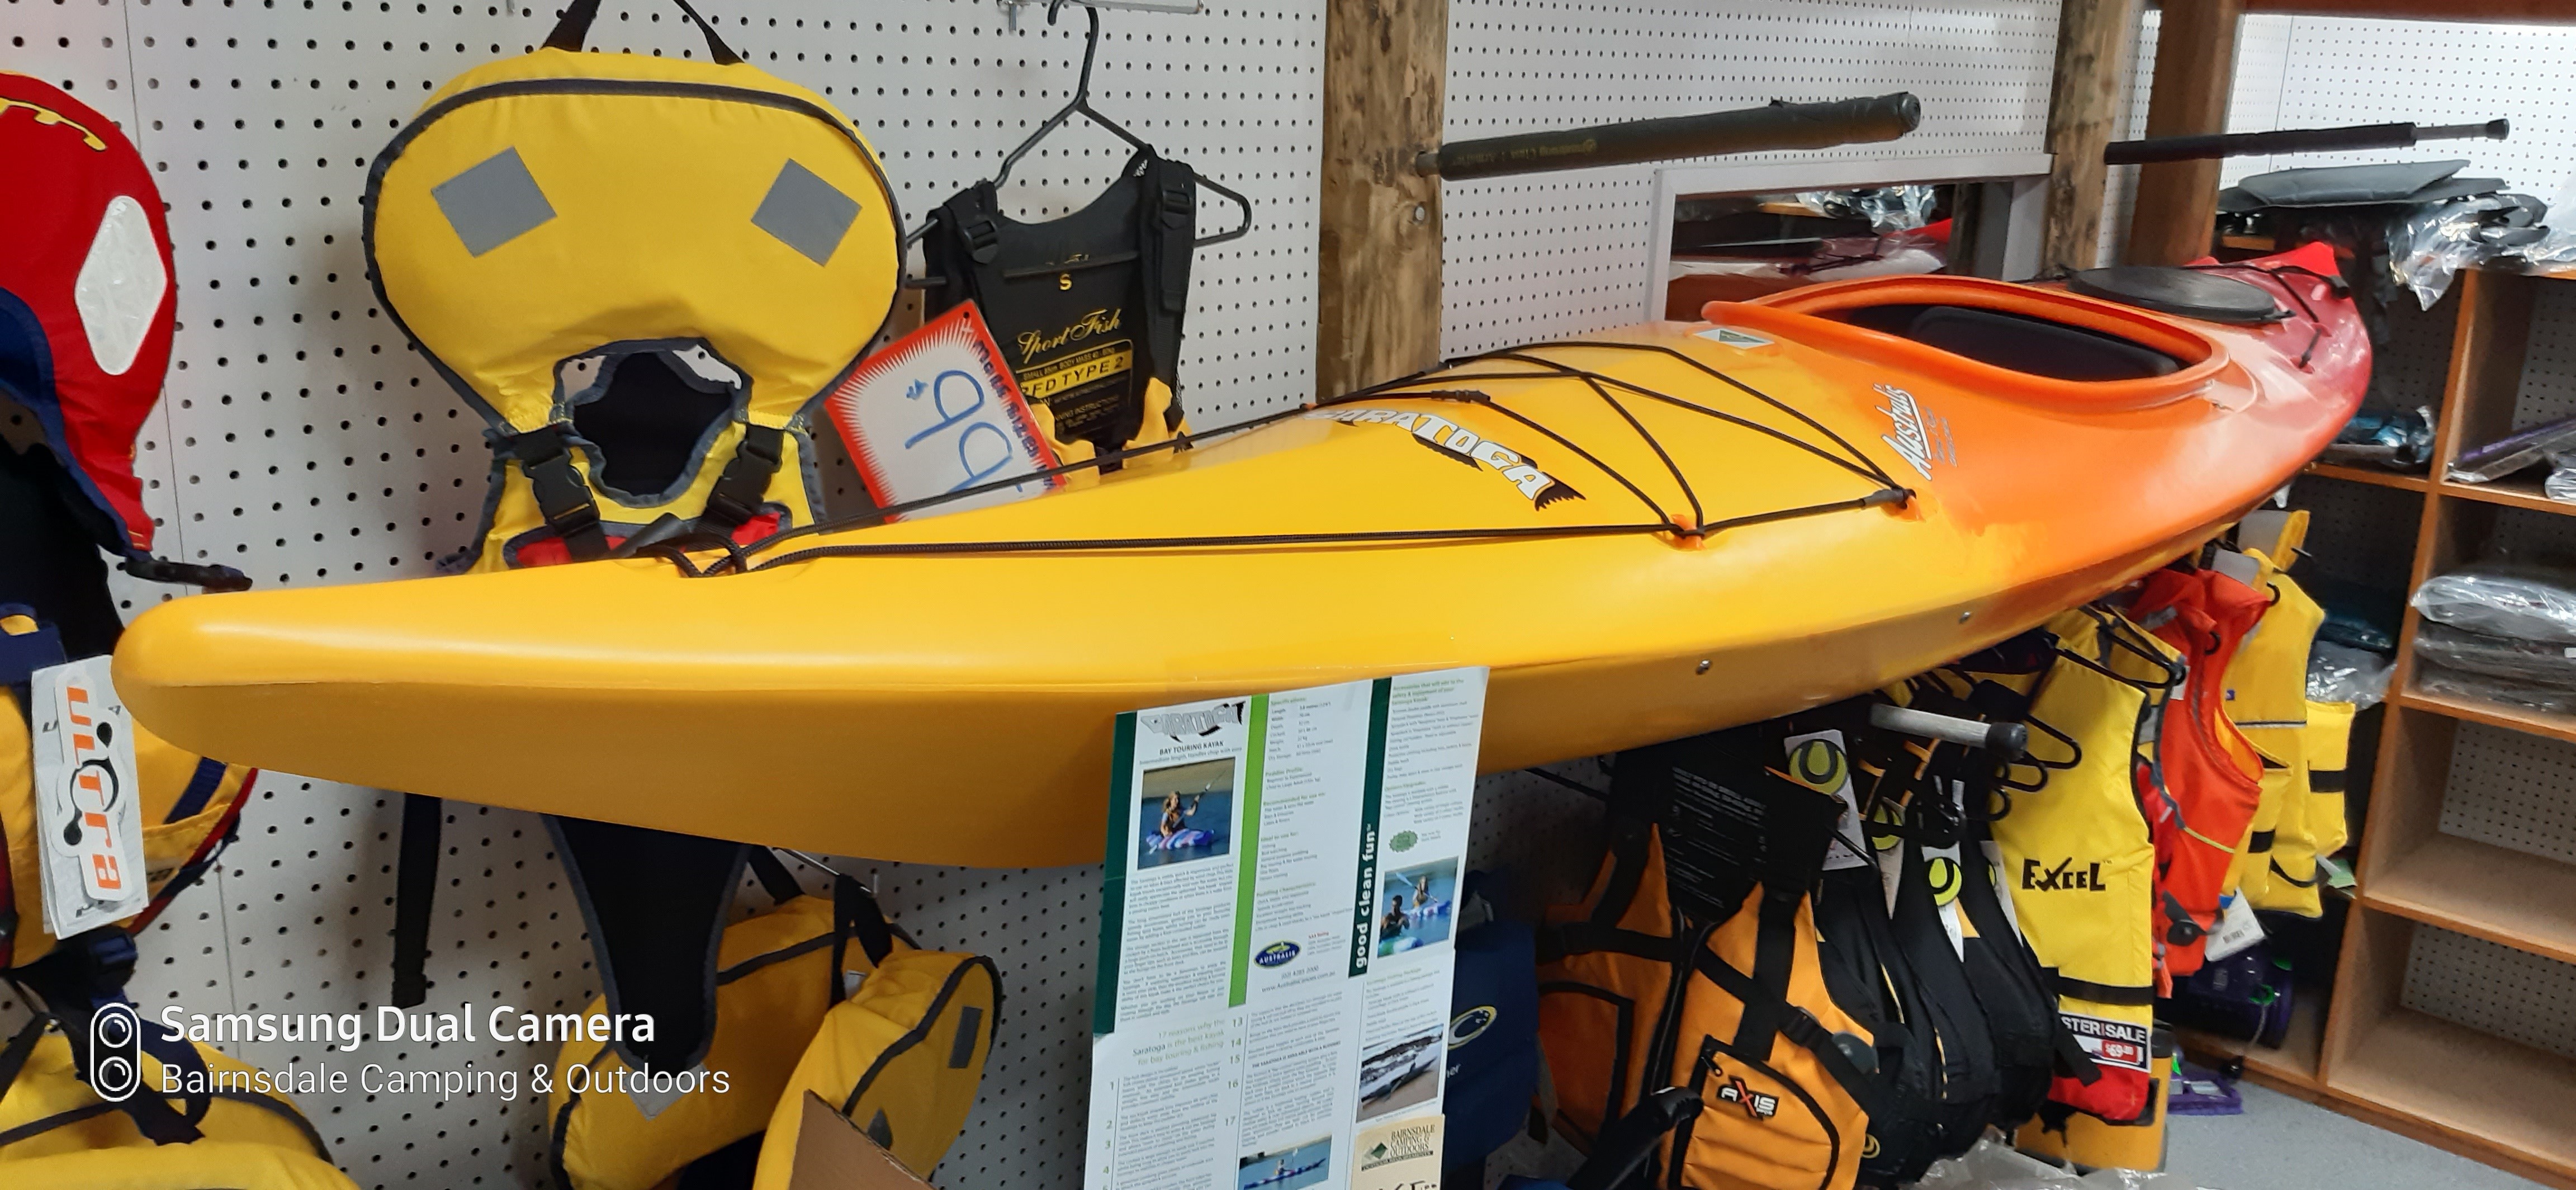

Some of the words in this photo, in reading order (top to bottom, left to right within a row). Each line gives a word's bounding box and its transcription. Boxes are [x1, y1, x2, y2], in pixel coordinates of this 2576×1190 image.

[1059, 273, 1073, 291] S
[1017, 327, 1071, 364] Sport
[1070, 308, 1122, 341] Fish
[1062, 359, 1110, 386] TYPE
[1114, 356, 1124, 369] 2
[1159, 747, 1172, 755] BAY
[1173, 743, 1202, 754] TOURING
[1203, 740, 1224, 749] KAYAK
[2021, 856, 2106, 892] EXCEL
[1358, 867, 1374, 917] clean
[1355, 922, 1368, 969] good
[1233, 1017, 1243, 1027] 13
[2105, 1024, 2147, 1045] SALE
[1132, 1043, 1166, 1056] Saratoga
[1231, 1037, 1242, 1048] 14
[1230, 1055, 1240, 1064] 15
[1110, 1081, 1114, 1090] 1
[1228, 1079, 1239, 1089] 16
[1721, 1080, 1776, 1118] AXIS
[1224, 1116, 1236, 1127] 17
[1391, 1124, 1436, 1141] BAIRNSDALE
[1390, 1135, 1423, 1147] CAMPING
[1390, 1143, 1429, 1158] OUTDOORS
